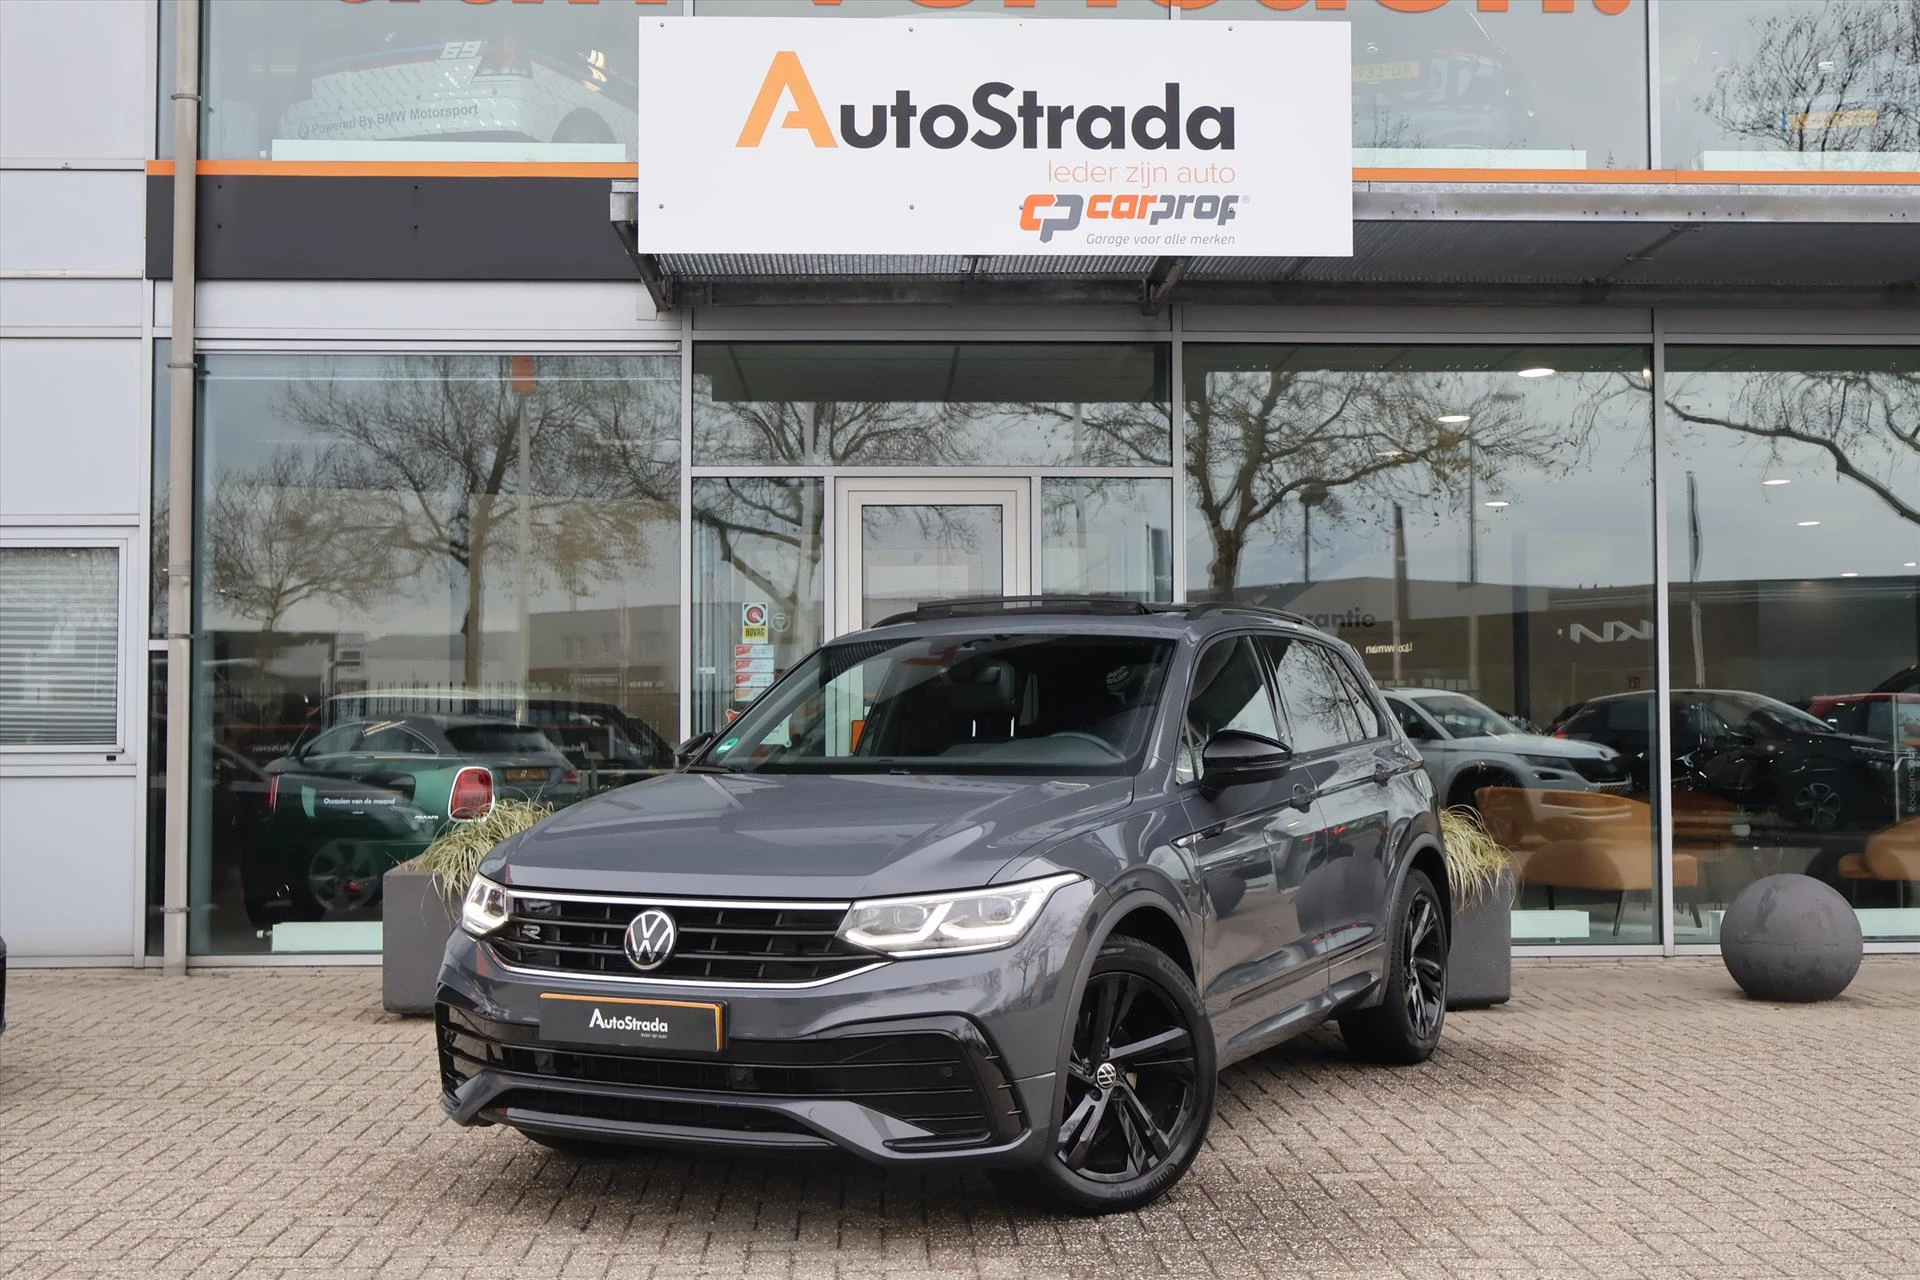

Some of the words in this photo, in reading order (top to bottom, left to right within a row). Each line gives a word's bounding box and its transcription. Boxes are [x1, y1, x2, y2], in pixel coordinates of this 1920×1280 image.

[440, 41, 482, 59] 69
[735, 51, 1236, 150] AutoStrada
[311, 117, 356, 135] Powered
[359, 115, 374, 129] By
[377, 110, 407, 125] BMW
[410, 104, 479, 121] Motorsport
[1048, 160, 1118, 184] Ieder
[1126, 162, 1168, 188] zijn
[1177, 162, 1236, 184] auto
[1086, 233, 1130, 247] Garage
[1134, 234, 1161, 245] voor
[1164, 233, 1187, 245] alle
[1190, 233, 1236, 245] merken
[745, 627, 765, 637] BOVAG
[588, 1007, 669, 1034] AutoStrada
